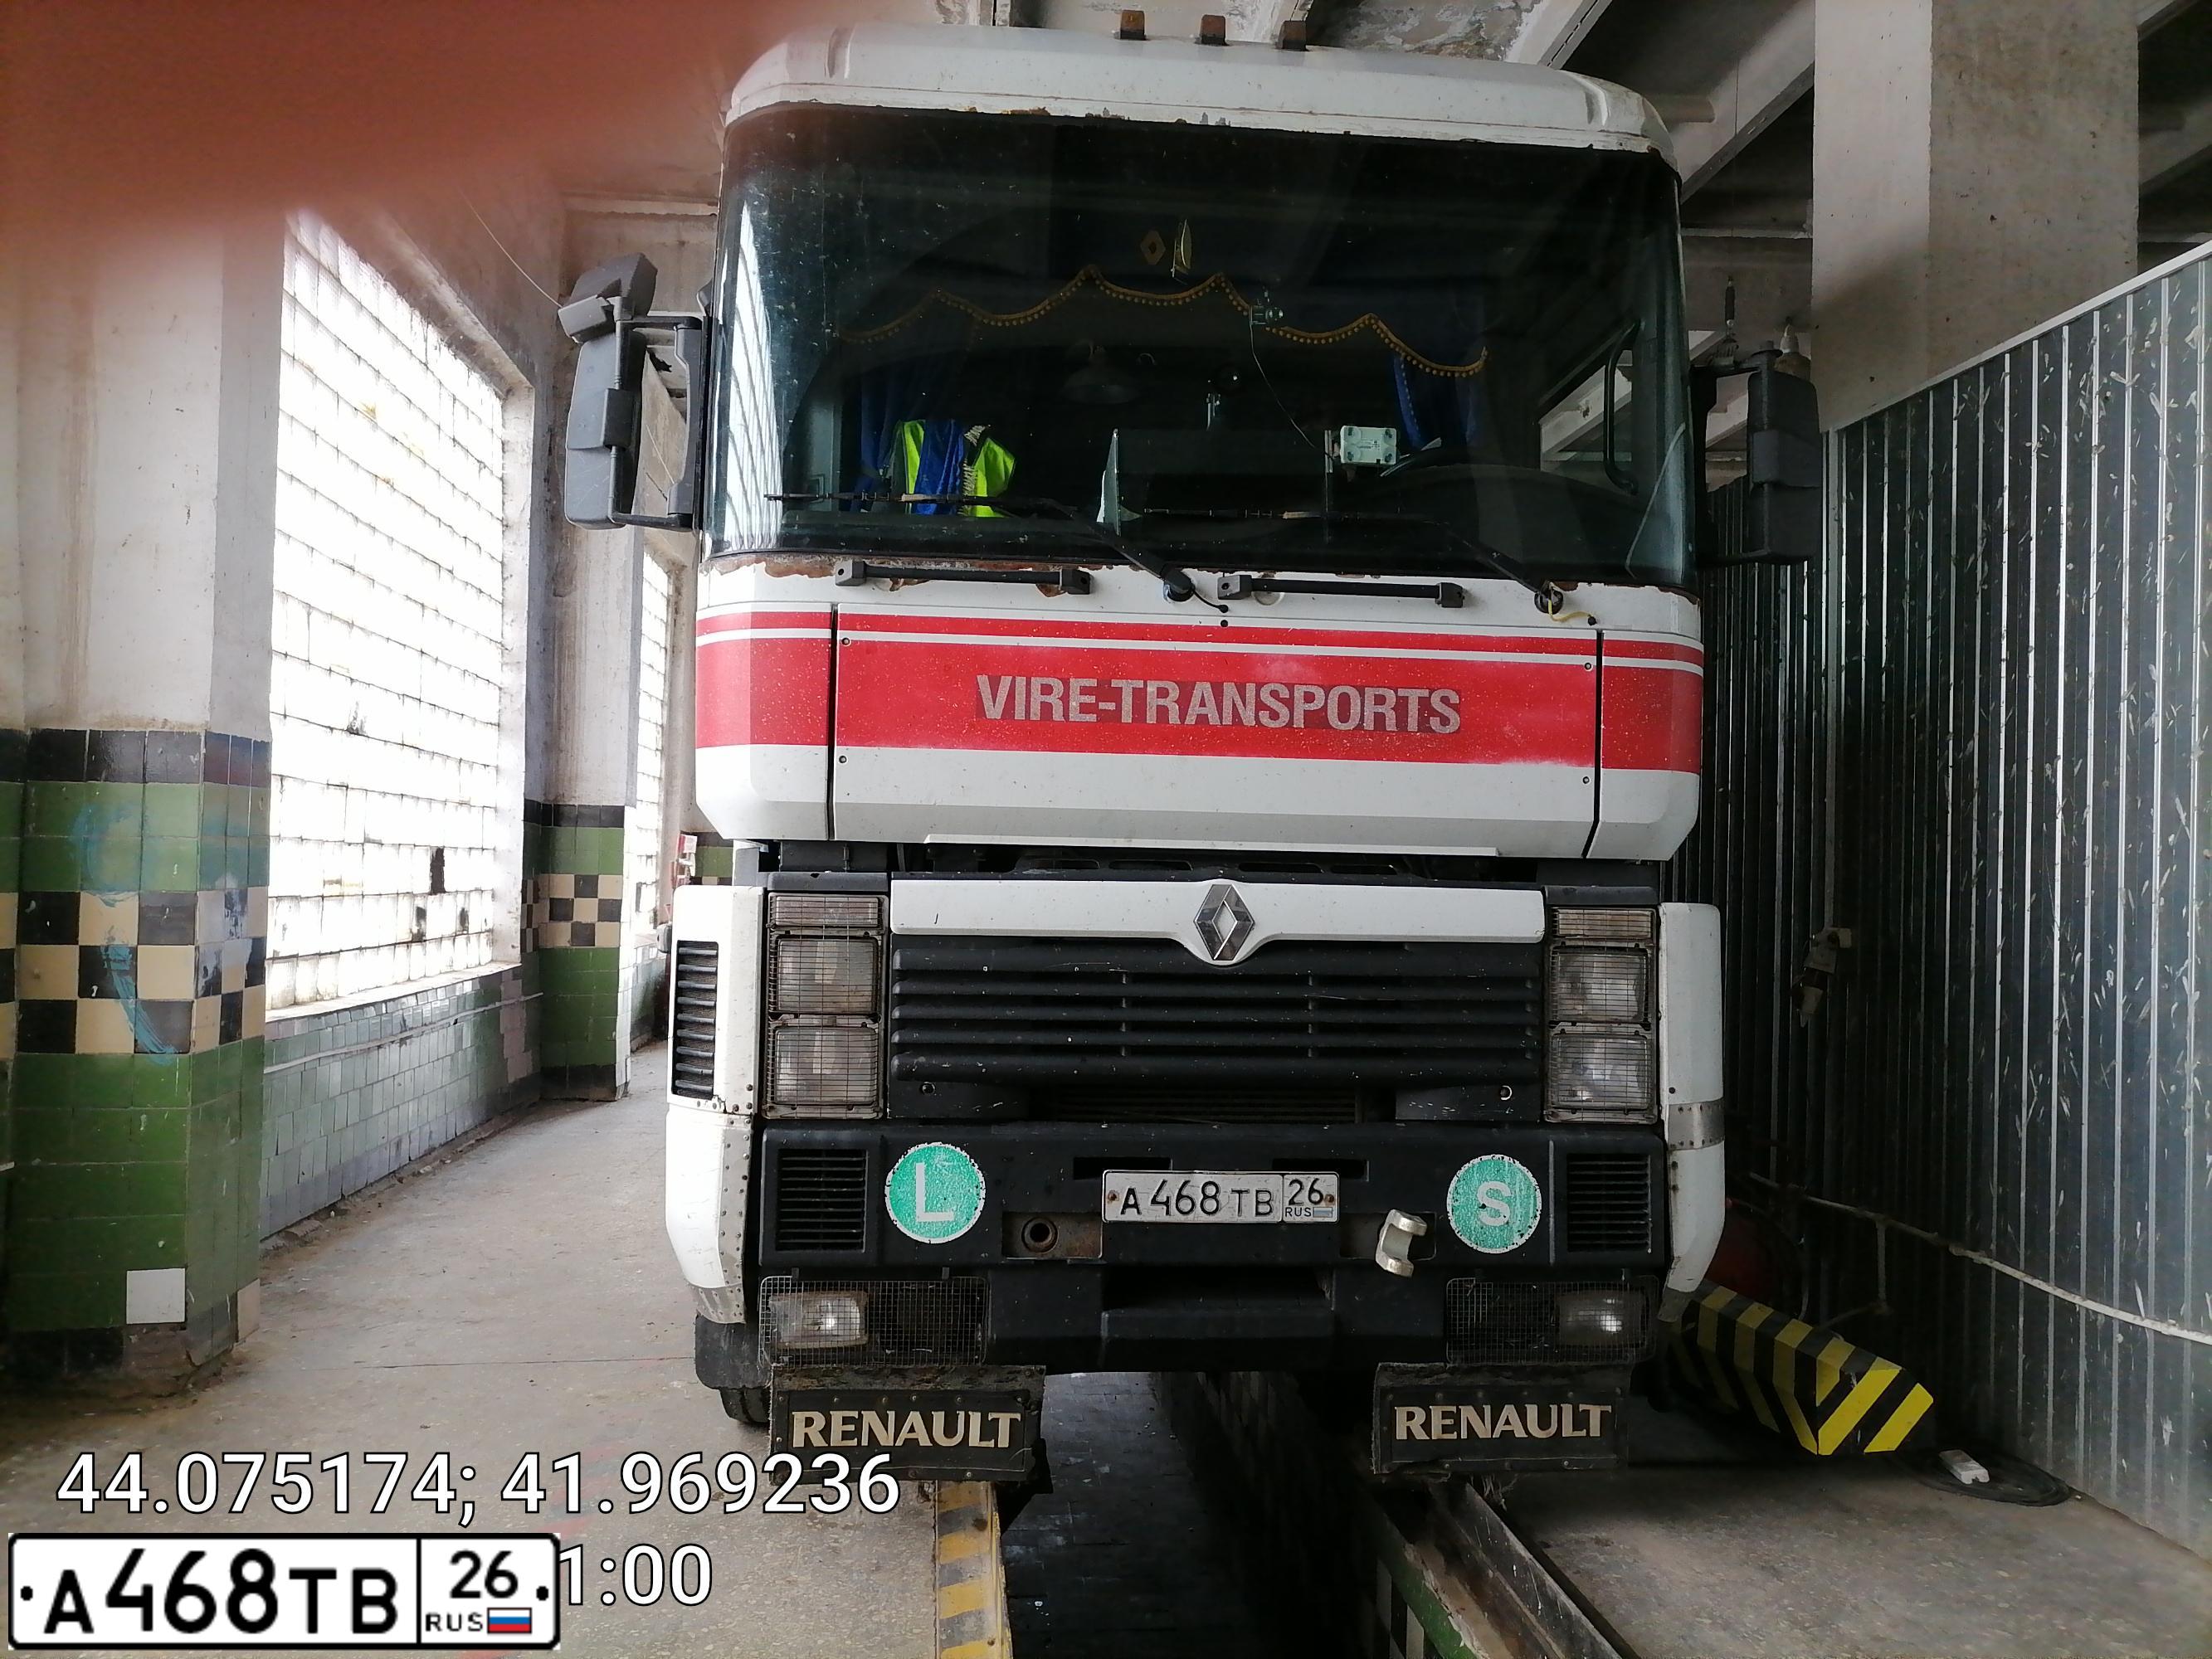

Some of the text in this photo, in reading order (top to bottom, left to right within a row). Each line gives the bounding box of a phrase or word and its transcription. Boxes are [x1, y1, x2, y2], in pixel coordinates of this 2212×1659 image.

[976, 674, 1462, 736] VIRE-TRANSPORTS
[915, 1162, 955, 1223] L
[1288, 1178, 1325, 1206] 26
[1477, 1180, 1513, 1227] S
[1284, 1206, 1313, 1218] RUS
[792, 1409, 1021, 1448] RENAULT
[1394, 1403, 1612, 1440] RENAULT
